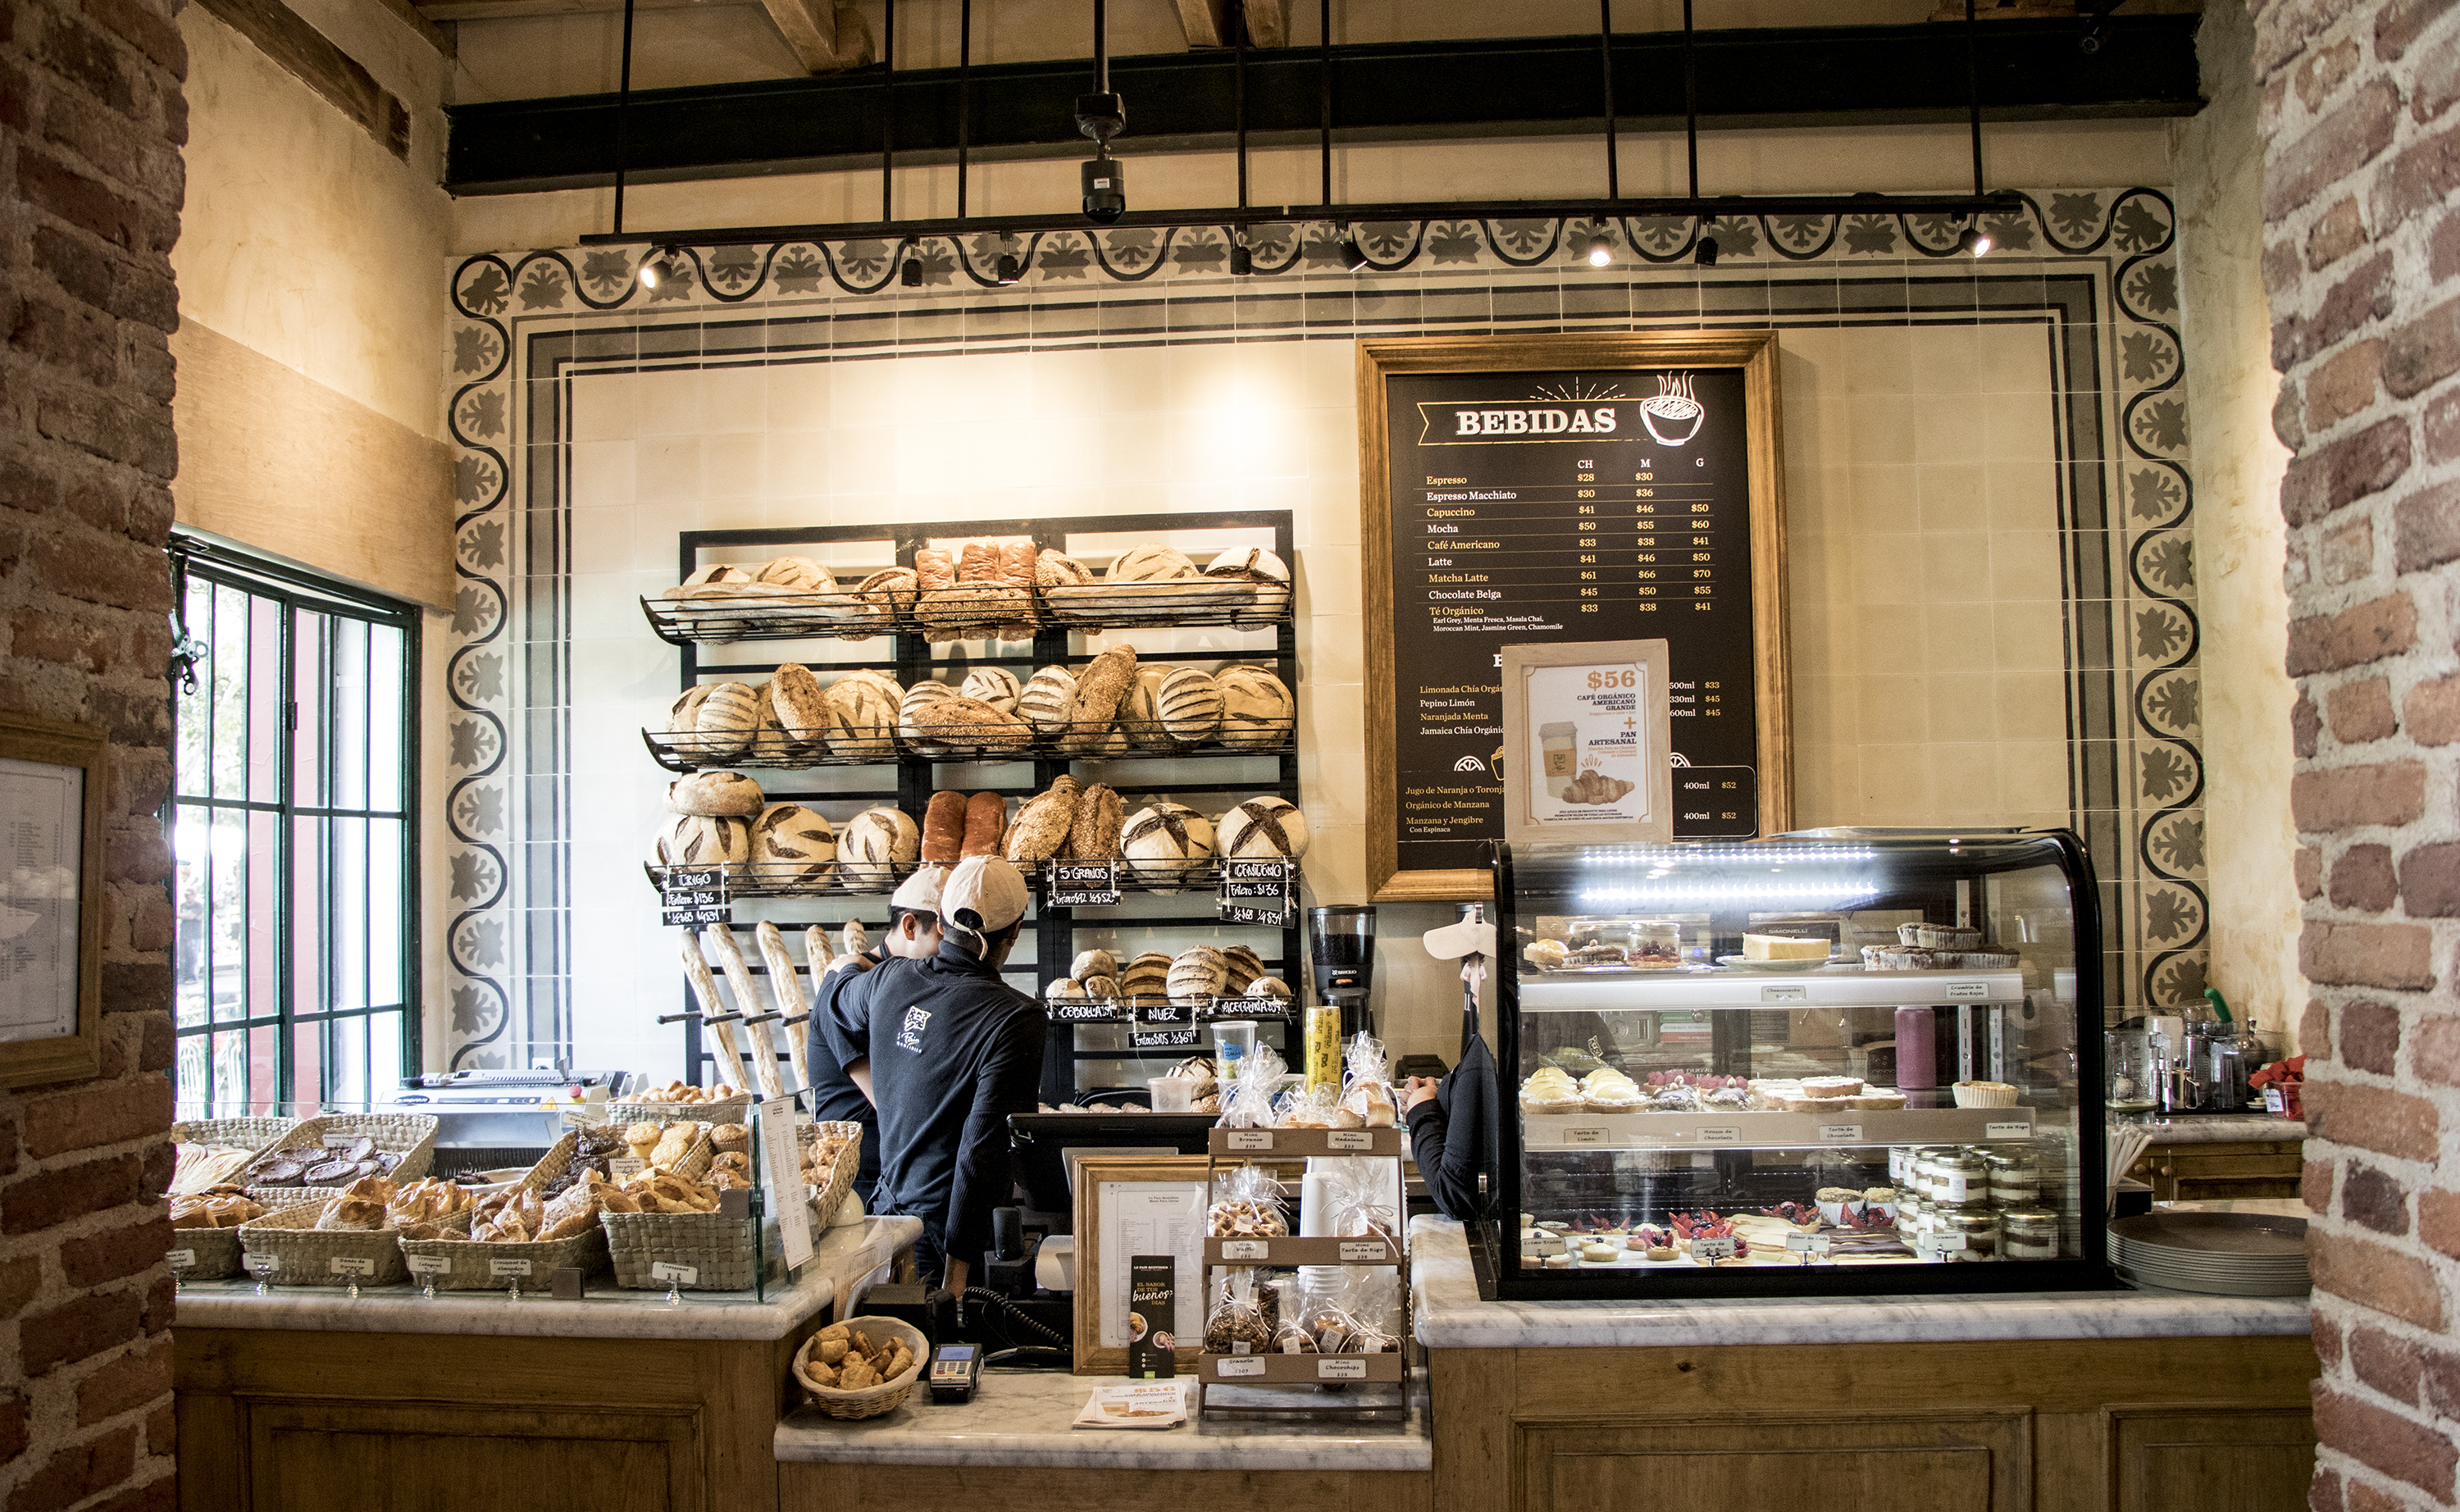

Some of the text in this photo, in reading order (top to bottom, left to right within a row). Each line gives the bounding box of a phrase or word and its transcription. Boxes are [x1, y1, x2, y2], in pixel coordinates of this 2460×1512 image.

[1456, 408, 1616, 436] BEBIDAS
[1577, 458, 1704, 469] CH M G
[1426, 471, 1653, 486] Espresso $28 $30
[1426, 488, 1653, 502] Espresso Macchiato $30 $36
[1427, 503, 1709, 517] Capuccino $41 $46 $50
[1427, 520, 1709, 534] Mocha $50 $55 $60
[1428, 536, 1709, 549] Café Americano $33 $38 $41
[1428, 553, 1710, 567] Latte $41 $46 $50
[1428, 569, 1711, 583] Matcha Latte $61 $66 $70
[1428, 585, 1711, 600] Chocolate Belga $45 $50 $55
[1429, 602, 1711, 617] Té Orgánico $33 $38 $41
[1446, 617, 1462, 626] Grey,
[1506, 624, 1527, 632] Green,
[1419, 681, 1720, 694] Limonada Chía 500ml $33
[1588, 670, 1636, 691] $56
[1419, 695, 1720, 709] Pepino Limón 330ml $45
[1420, 708, 1720, 722] Naranjada Menta 600ml $45
[1420, 726, 1473, 736] Jamaica Chía
[1405, 786, 1427, 796] Jugo
[1428, 786, 1437, 794] de
[1438, 786, 1468, 795] Naranja
[1683, 781, 1710, 790] 400ml
[1721, 781, 1737, 790] $52
[1405, 800, 1490, 812] Orgánico de Manzana
[1406, 811, 1737, 827] Manzana y Jengibre 400ml $52
[1423, 826, 1450, 835] Espinaca
[1059, 867, 1108, 880] 5 GRANOS
[1235, 863, 1282, 877] CENTENO
[677, 873, 711, 886] TRIGO
[1257, 883, 1278, 896] $136
[694, 891, 714, 904] $136
[1148, 1007, 1180, 1021] NUEZ
[662, 1264, 690, 1272] Croissant
[1132, 1290, 1169, 1302] buenos
